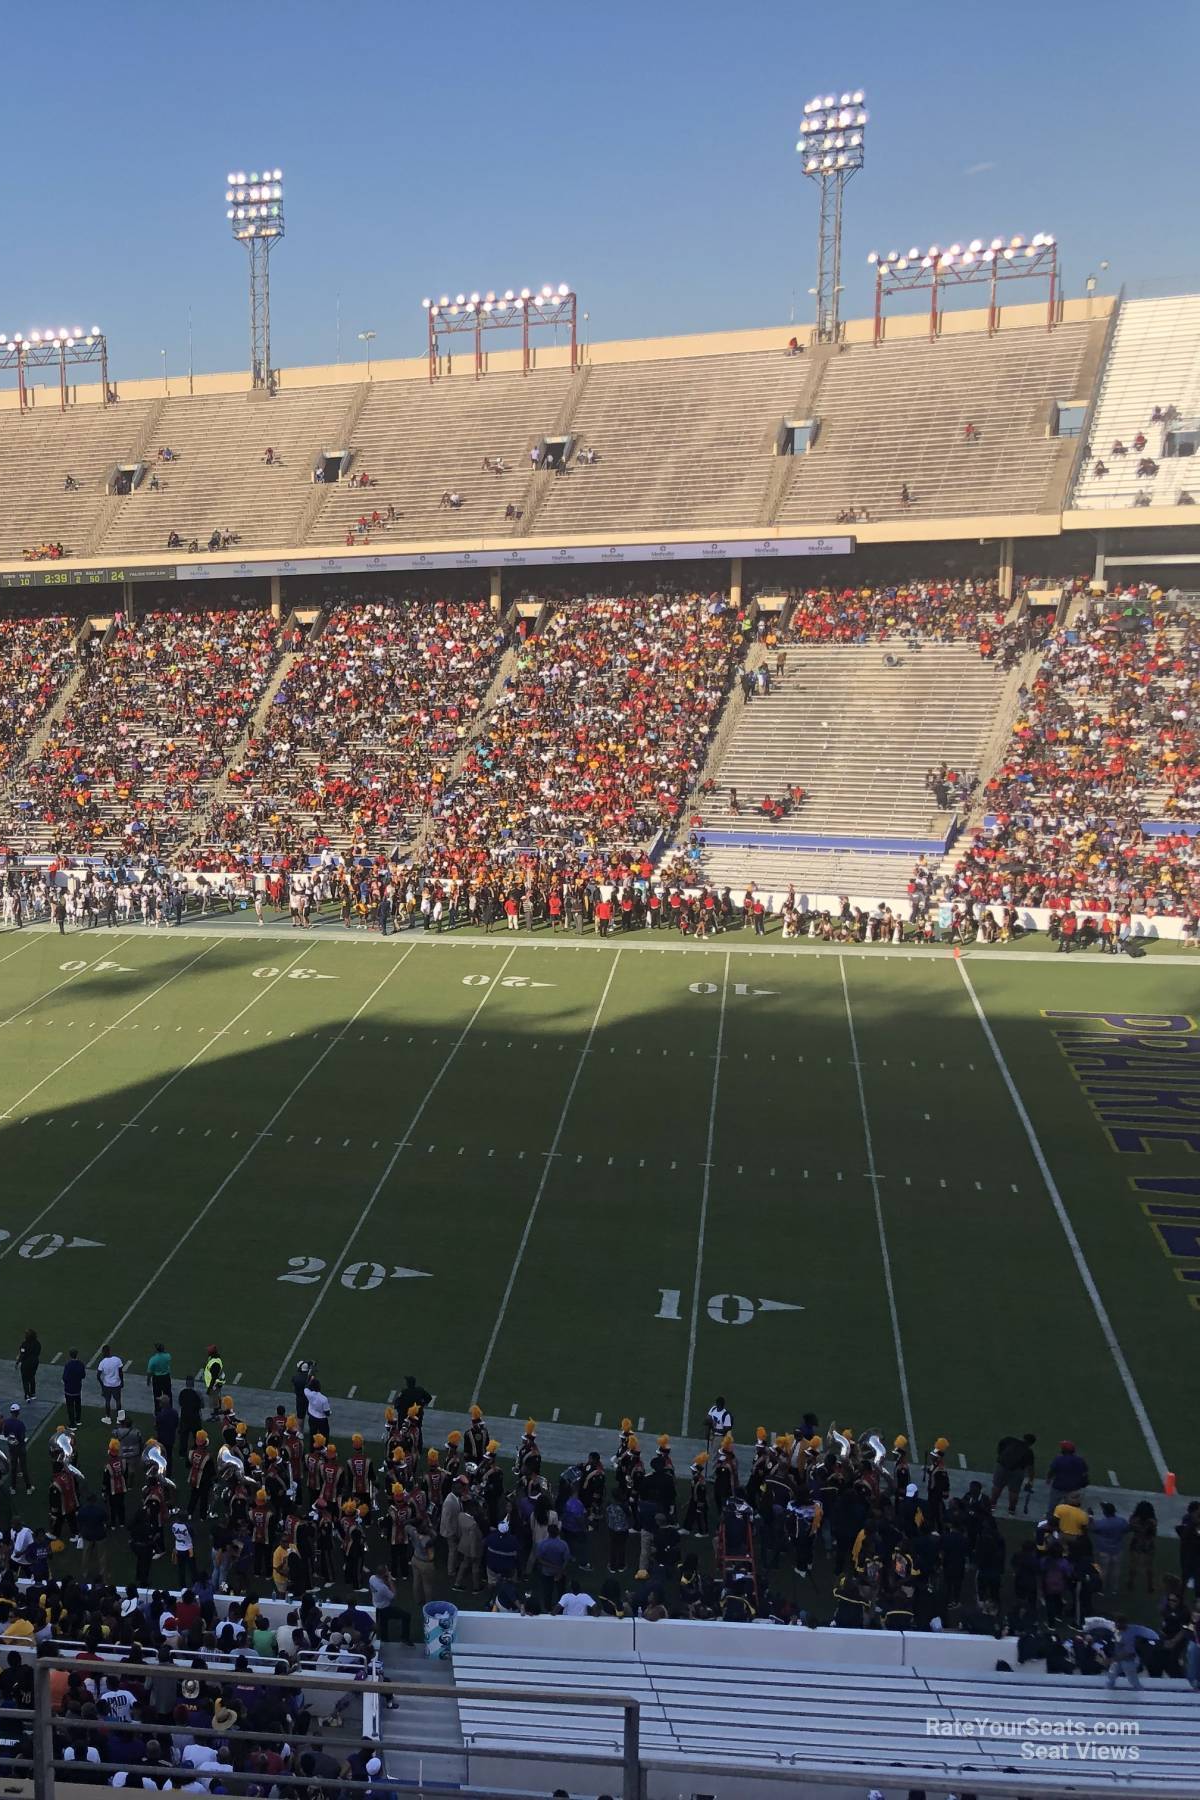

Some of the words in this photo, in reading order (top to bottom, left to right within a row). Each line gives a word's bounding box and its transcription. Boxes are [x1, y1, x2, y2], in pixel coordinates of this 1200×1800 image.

[44, 574, 67, 584] 2:39
[111, 572, 125, 580] 24
[58, 960, 118, 972] 40
[251, 967, 318, 980] 30
[461, 974, 531, 988] 20
[688, 982, 750, 996] 10
[277, 1256, 386, 1289] 20
[653, 1288, 755, 1325] 10
